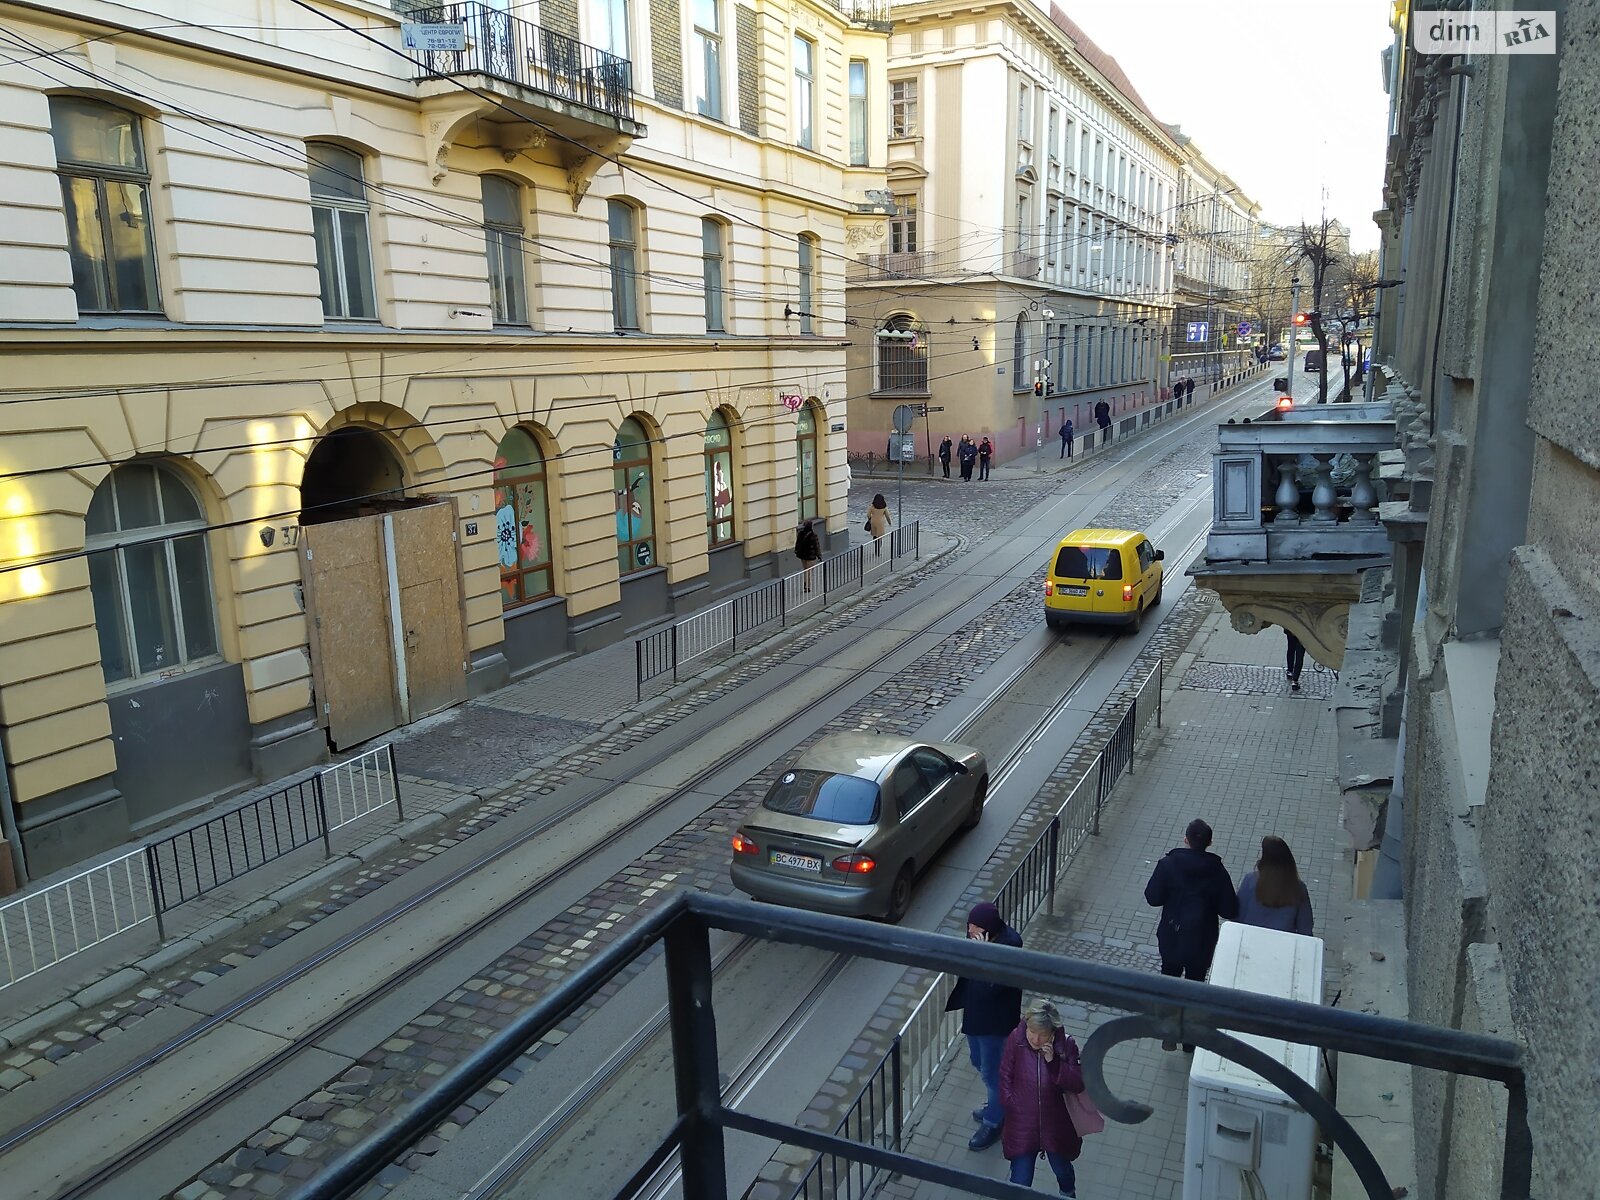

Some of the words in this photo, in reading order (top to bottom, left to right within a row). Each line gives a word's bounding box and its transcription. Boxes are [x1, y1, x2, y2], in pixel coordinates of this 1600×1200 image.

[280, 524, 299, 546] 37
[467, 524, 477, 535] 37
[776, 853, 787, 863] BC
[788, 856, 806, 867] 4977
[807, 860, 819, 870] BX
